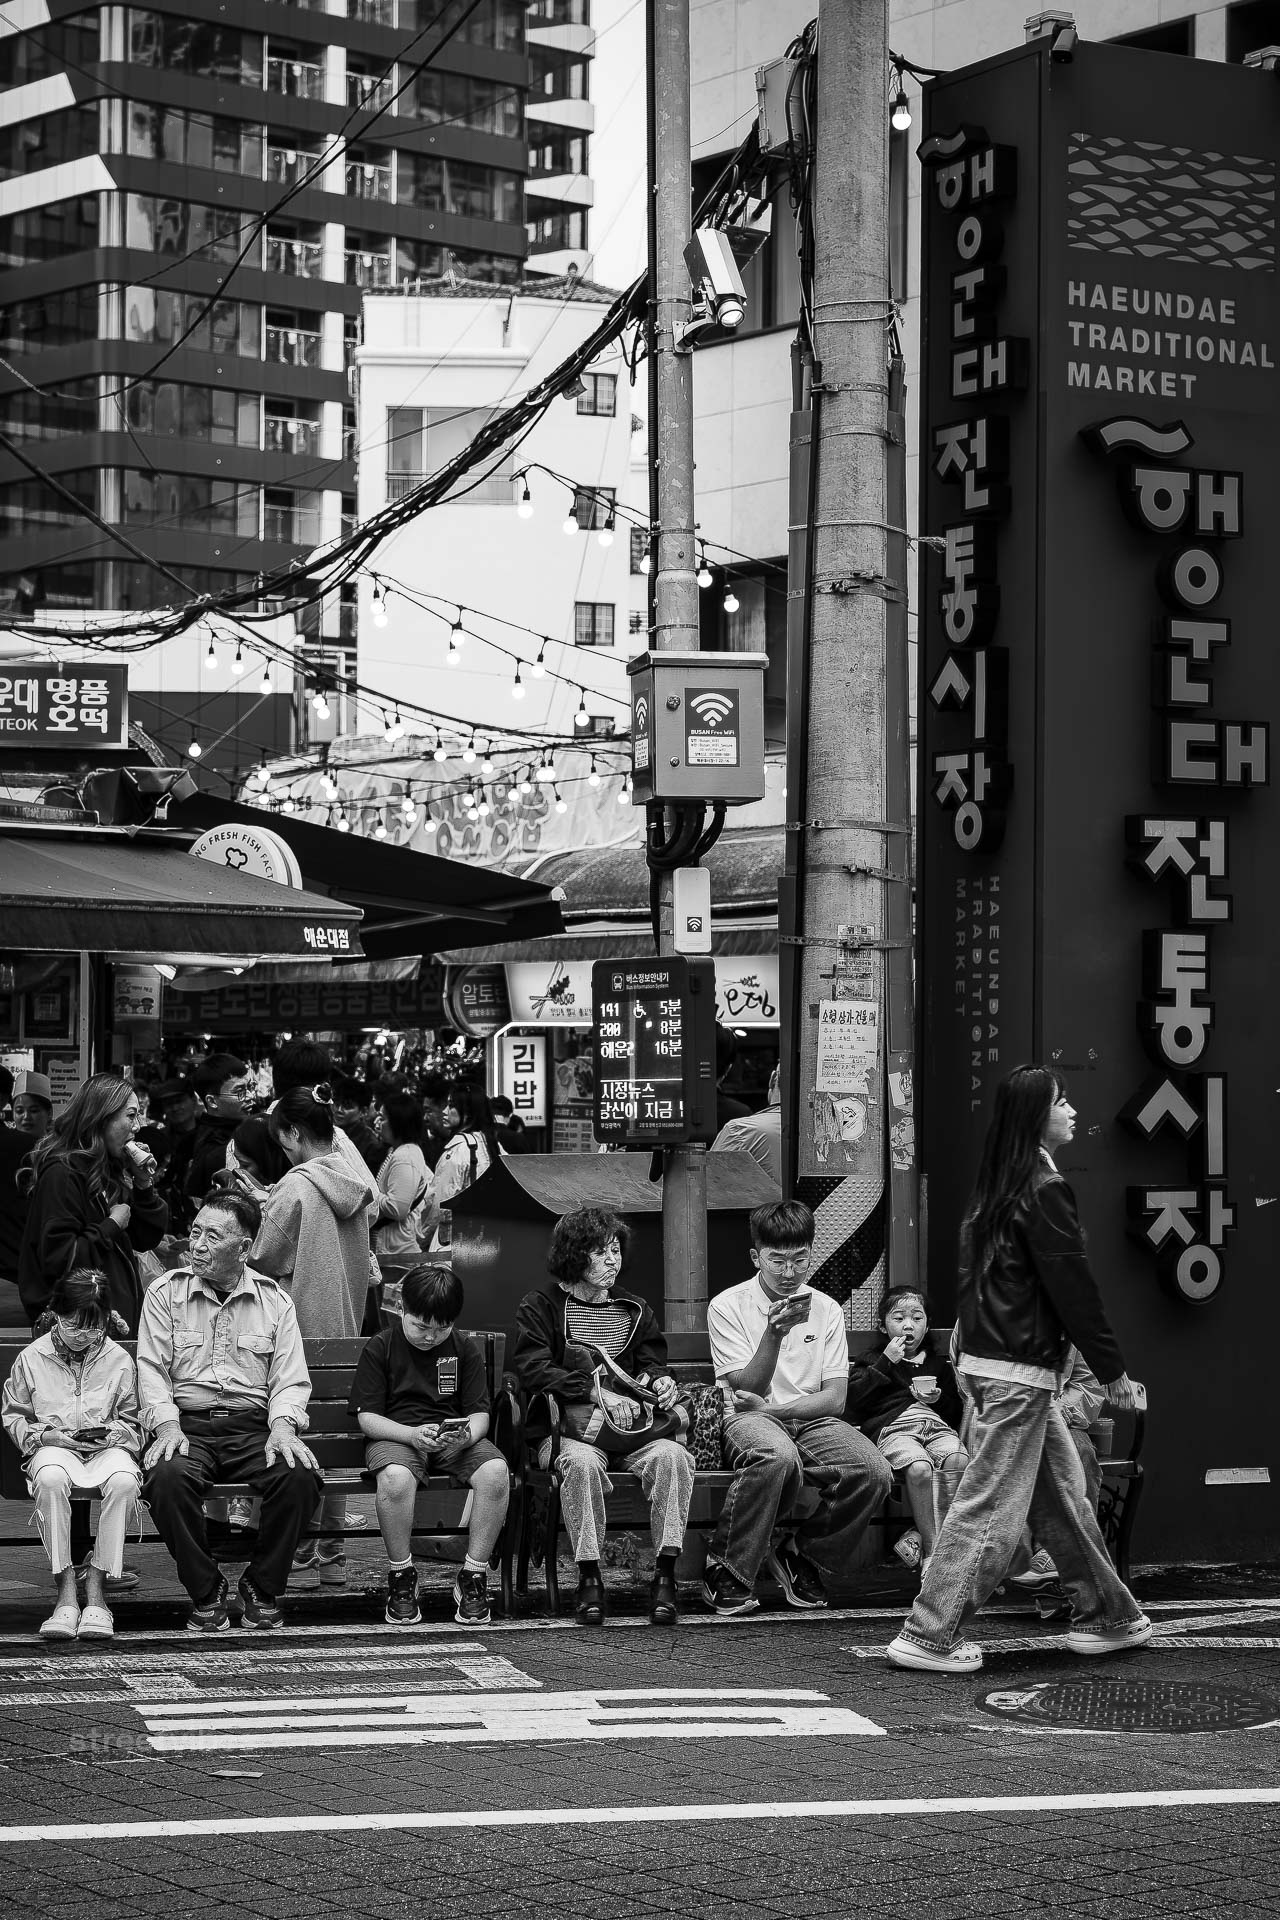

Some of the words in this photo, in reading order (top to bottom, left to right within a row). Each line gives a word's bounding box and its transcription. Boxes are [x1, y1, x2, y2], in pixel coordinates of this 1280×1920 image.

[917, 130, 1006, 397] 해운대
[1068, 281, 1236, 325] HAEUNDAE
[1068, 321, 1275, 368] TRADITIONAL
[1067, 362, 1197, 399] MARKET
[1100, 420, 1266, 782] 해운대
[930, 419, 991, 850] 전통시장
[46, 678, 110, 705] 명품
[46, 704, 108, 733] 호떡
[208, 831, 239, 846] FRESH
[241, 834, 262, 853] FISH
[303, 926, 350, 949] 해운대점
[955, 878, 967, 1016] MARKET
[625, 971, 669, 984] 버스정보안내기
[989, 876, 1000, 1062] HAEUNDAE
[600, 1002, 620, 1017] 141
[660, 999, 682, 1017] 5분
[971, 877, 982, 1113] TRADITIONAL
[599, 1022, 621, 1037] 200
[660, 1019, 682, 1037] 8분
[839, 1009, 854, 1025] 상가
[654, 1039, 683, 1057] 16분
[1137, 820, 1233, 1299] 전통시장
[513, 1043, 537, 1109] 김밥
[601, 1081, 655, 1100] 시정뉴스
[600, 1101, 638, 1120] 당신이
[644, 1101, 672, 1119] 지금
